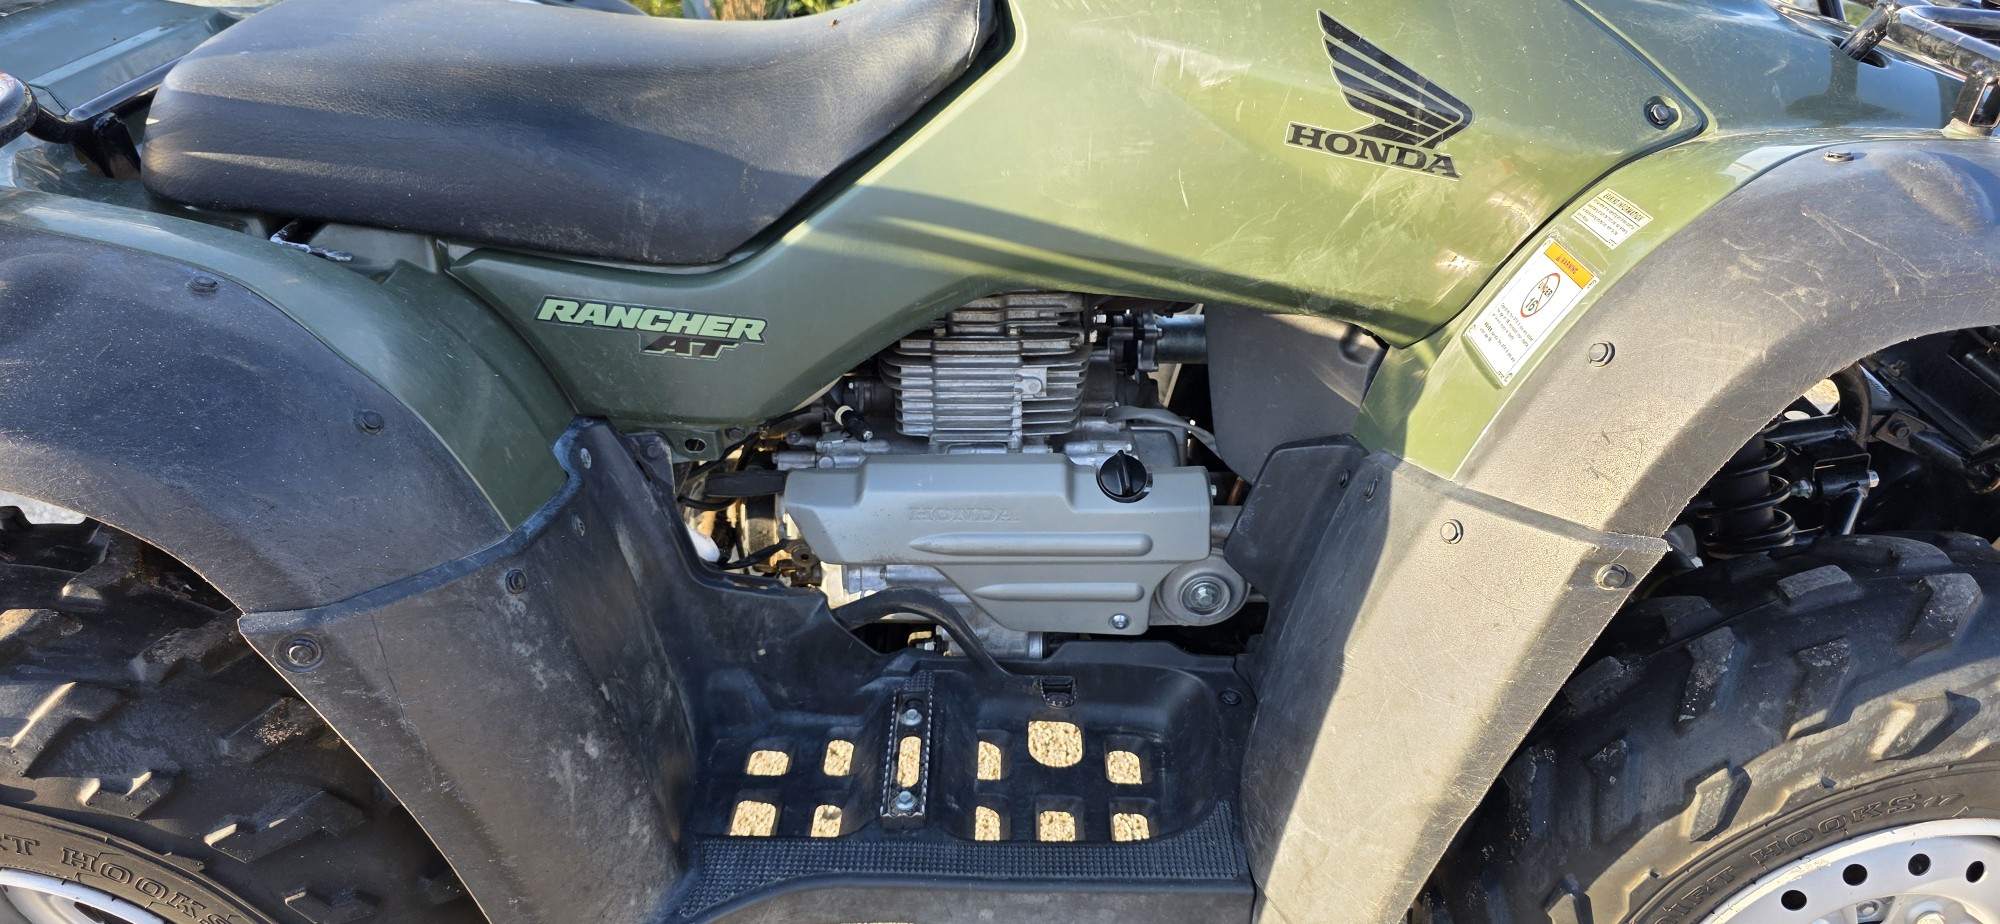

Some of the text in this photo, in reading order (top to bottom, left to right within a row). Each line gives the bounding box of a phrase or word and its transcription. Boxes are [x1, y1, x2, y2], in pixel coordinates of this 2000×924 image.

[1287, 124, 1460, 179] HONDA
[1525, 297, 1539, 312] 16
[536, 298, 767, 341] RANCHER
[641, 335, 739, 359] AT
[909, 507, 1020, 522] HONDA
[1750, 793, 1918, 865] HOOKS
[0, 834, 41, 855] T
